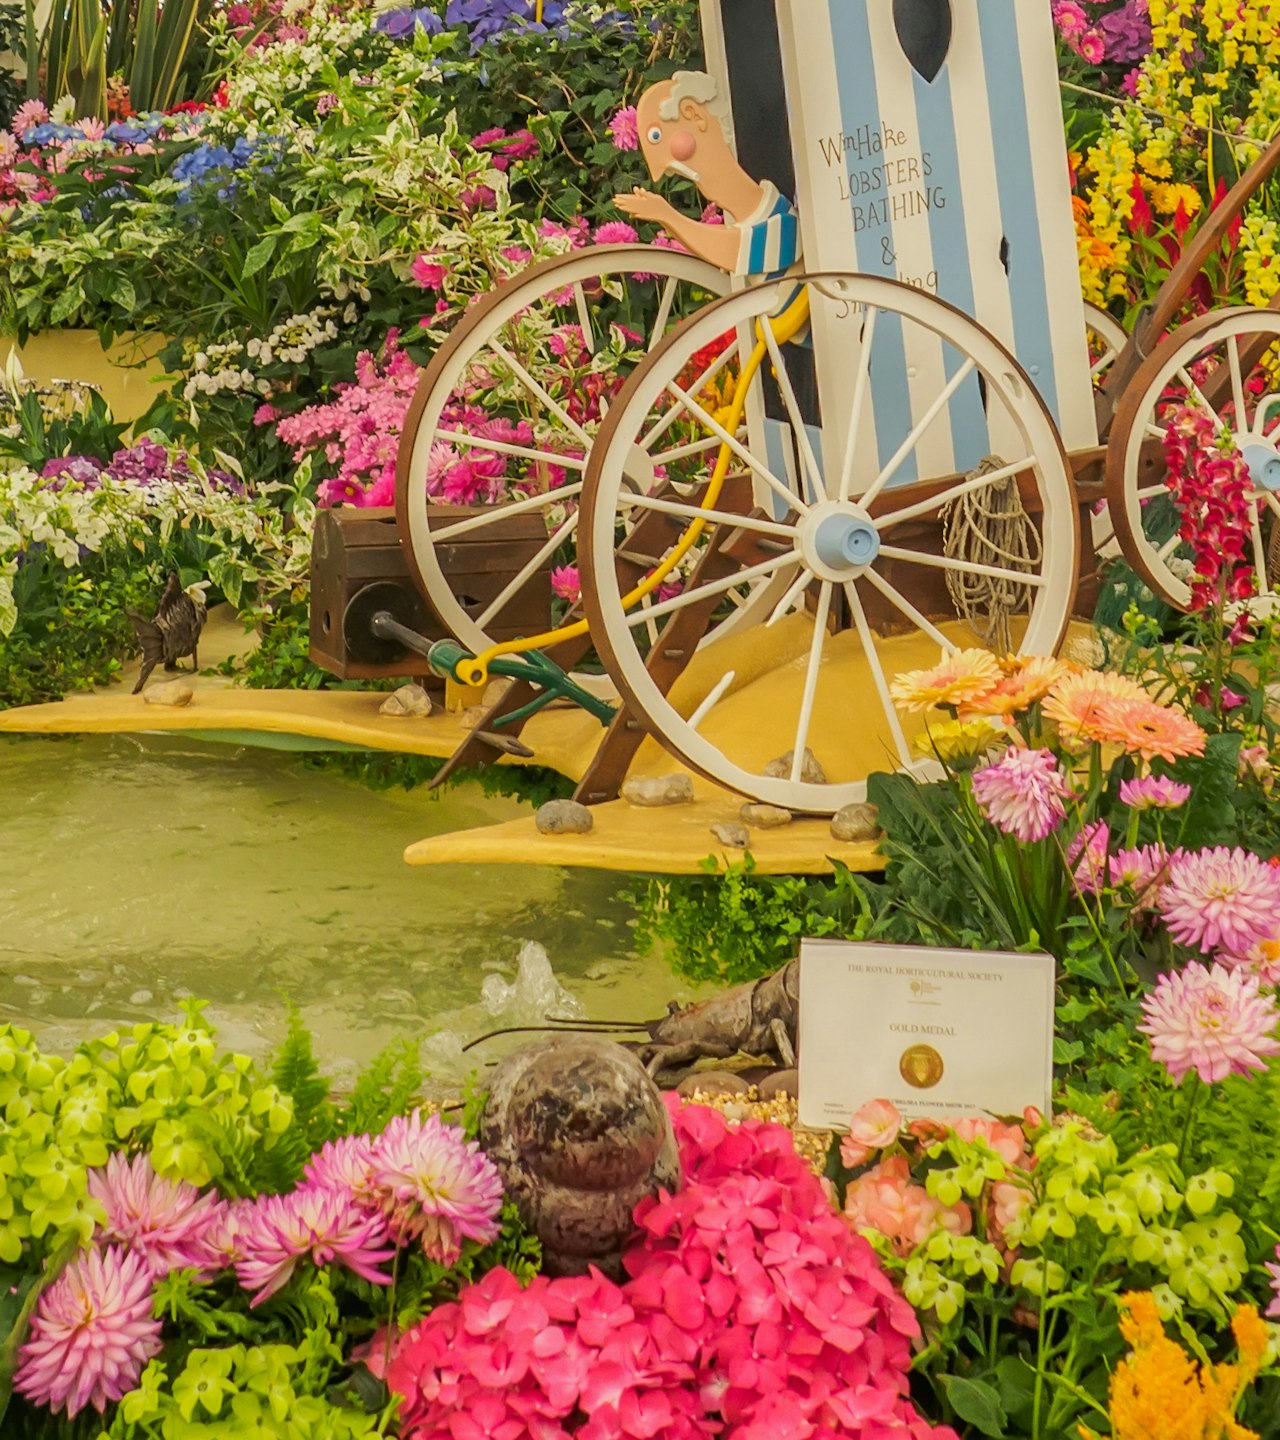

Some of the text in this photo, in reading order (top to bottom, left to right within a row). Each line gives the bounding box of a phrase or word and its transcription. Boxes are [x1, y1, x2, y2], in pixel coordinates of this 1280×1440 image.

[838, 152, 933, 201] LOBSTERS
[852, 187, 946, 232] BATHING
[880, 236, 898, 266] &
[847, 964, 1004, 982] THE ROYAL HORTICULTURAL SOCIETY
[889, 1022, 957, 1037] GOLD MEDAL
